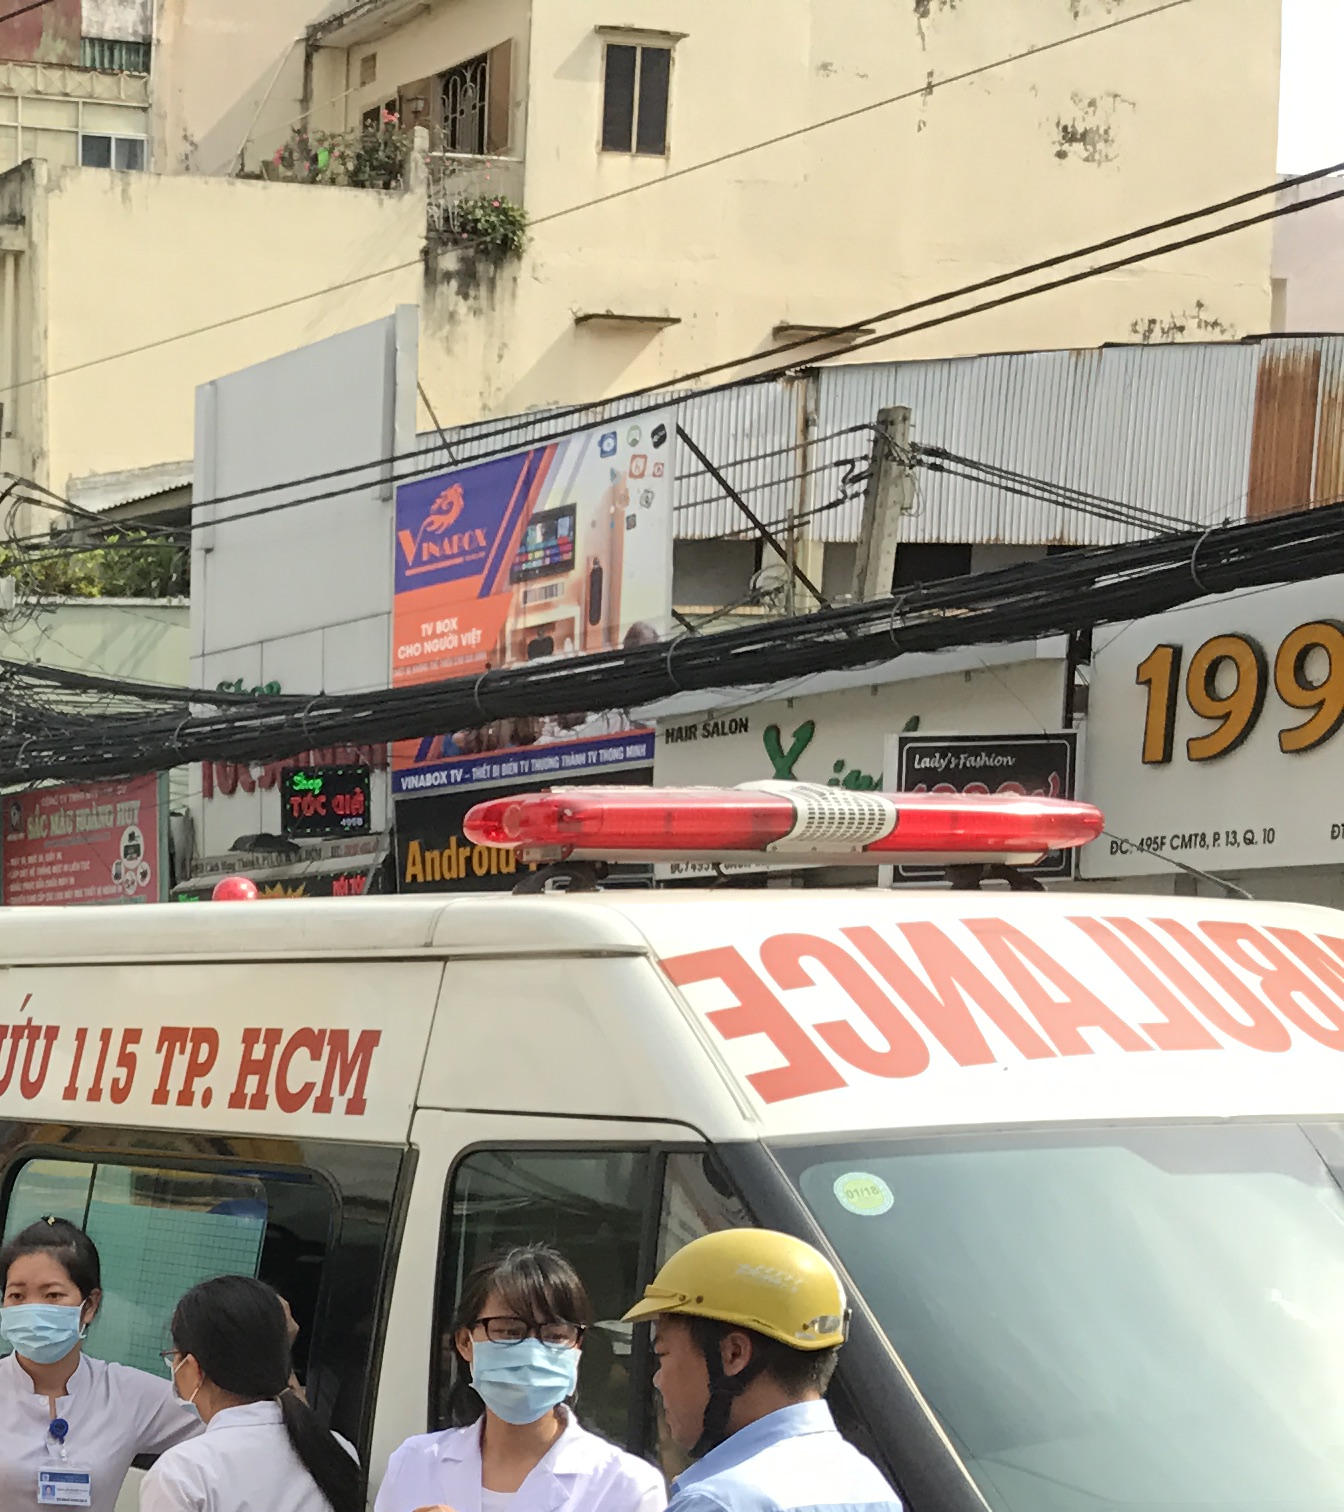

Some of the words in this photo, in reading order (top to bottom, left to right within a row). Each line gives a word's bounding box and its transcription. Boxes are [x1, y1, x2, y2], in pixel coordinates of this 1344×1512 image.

[421, 622, 435, 637] TV
[436, 616, 458, 633] BOX
[398, 642, 422, 660] CHO
[664, 724, 698, 745] HAIR
[702, 716, 750, 739] SALON
[914, 752, 958, 770] Lady's
[958, 752, 1016, 769] Fashion
[401, 771, 448, 790] VINABOX
[449, 768, 463, 784] TV
[1170, 832, 1210, 851] CMT8,
[1225, 829, 1241, 848] 13,
[1243, 828, 1258, 846] Q.
[1262, 827, 1276, 844] 10
[405, 835, 516, 883] Android
[63, 1027, 143, 1105] 115
[152, 1026, 221, 1109] TP.
[228, 1027, 383, 1116] HCM
